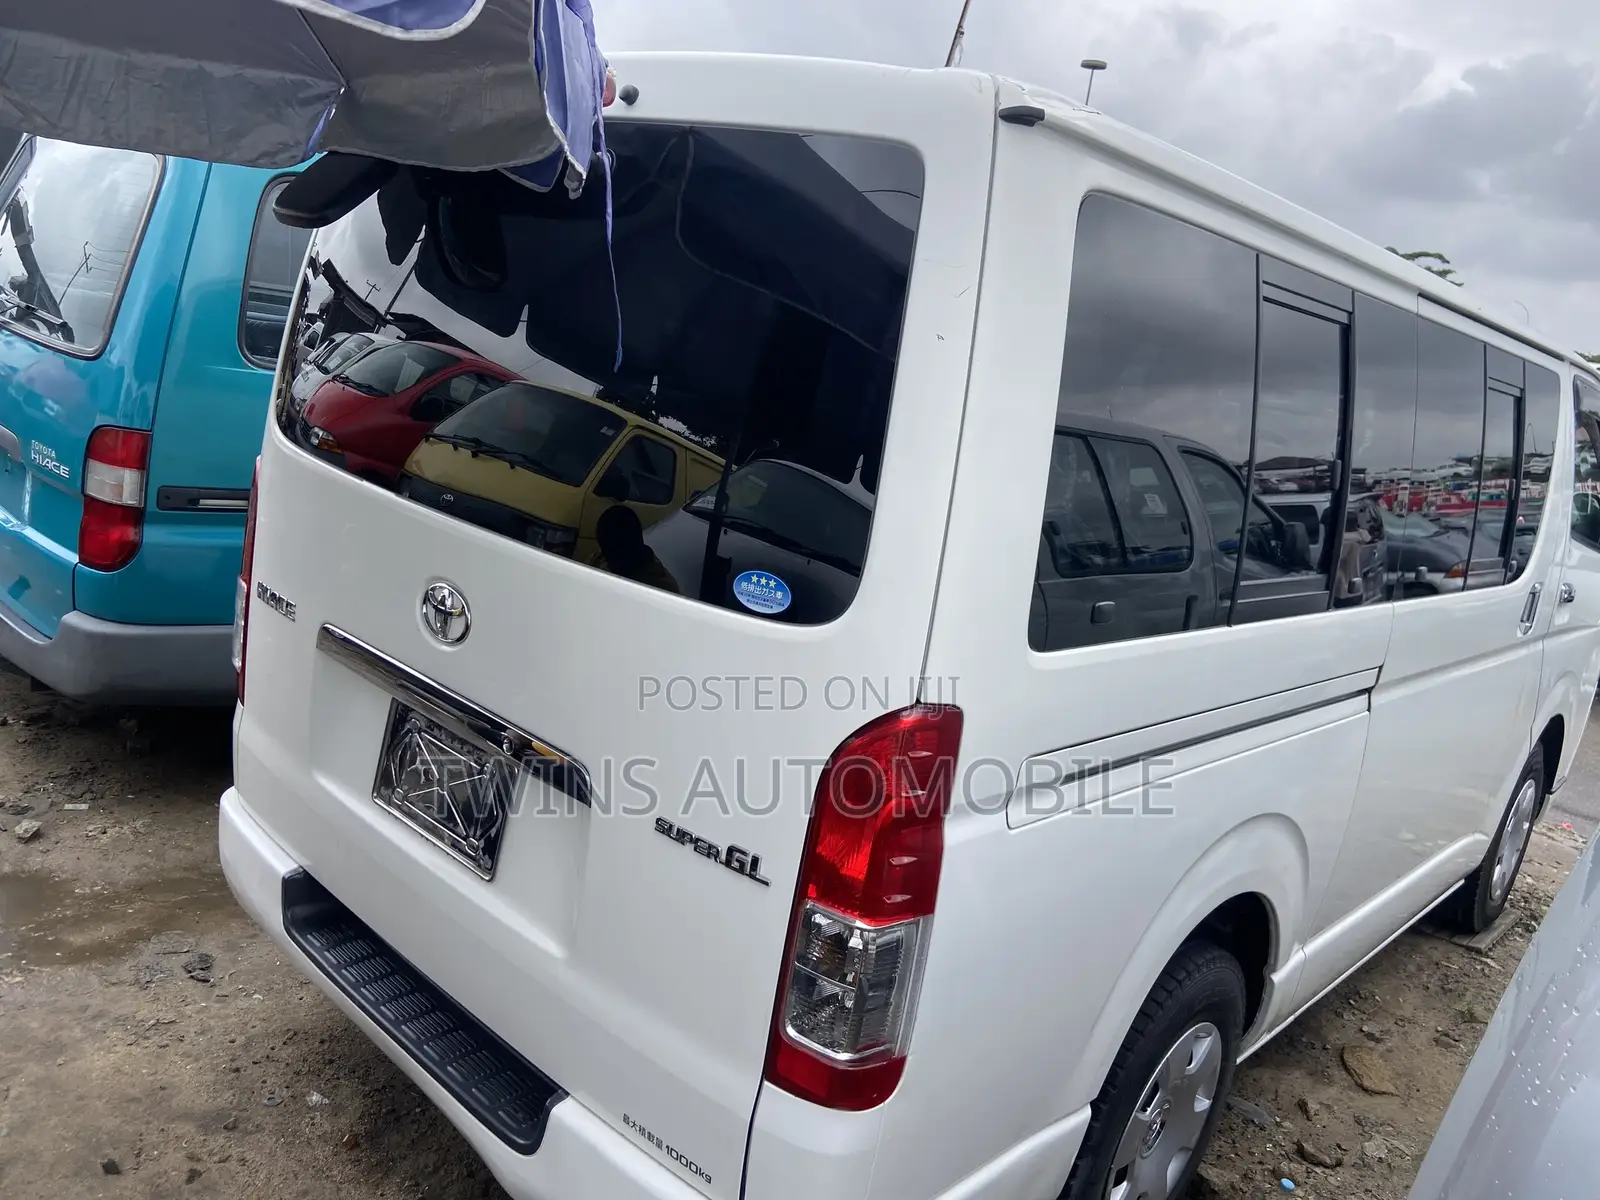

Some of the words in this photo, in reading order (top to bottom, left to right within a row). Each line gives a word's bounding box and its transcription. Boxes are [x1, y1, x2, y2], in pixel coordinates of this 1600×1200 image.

[31, 439, 56, 460] TOYOTA
[31, 449, 70, 479] HIACE
[256, 580, 297, 623] HIACE
[654, 815, 722, 864] SUPER
[724, 842, 772, 887] GL
[665, 1143, 713, 1185] 1000kg
